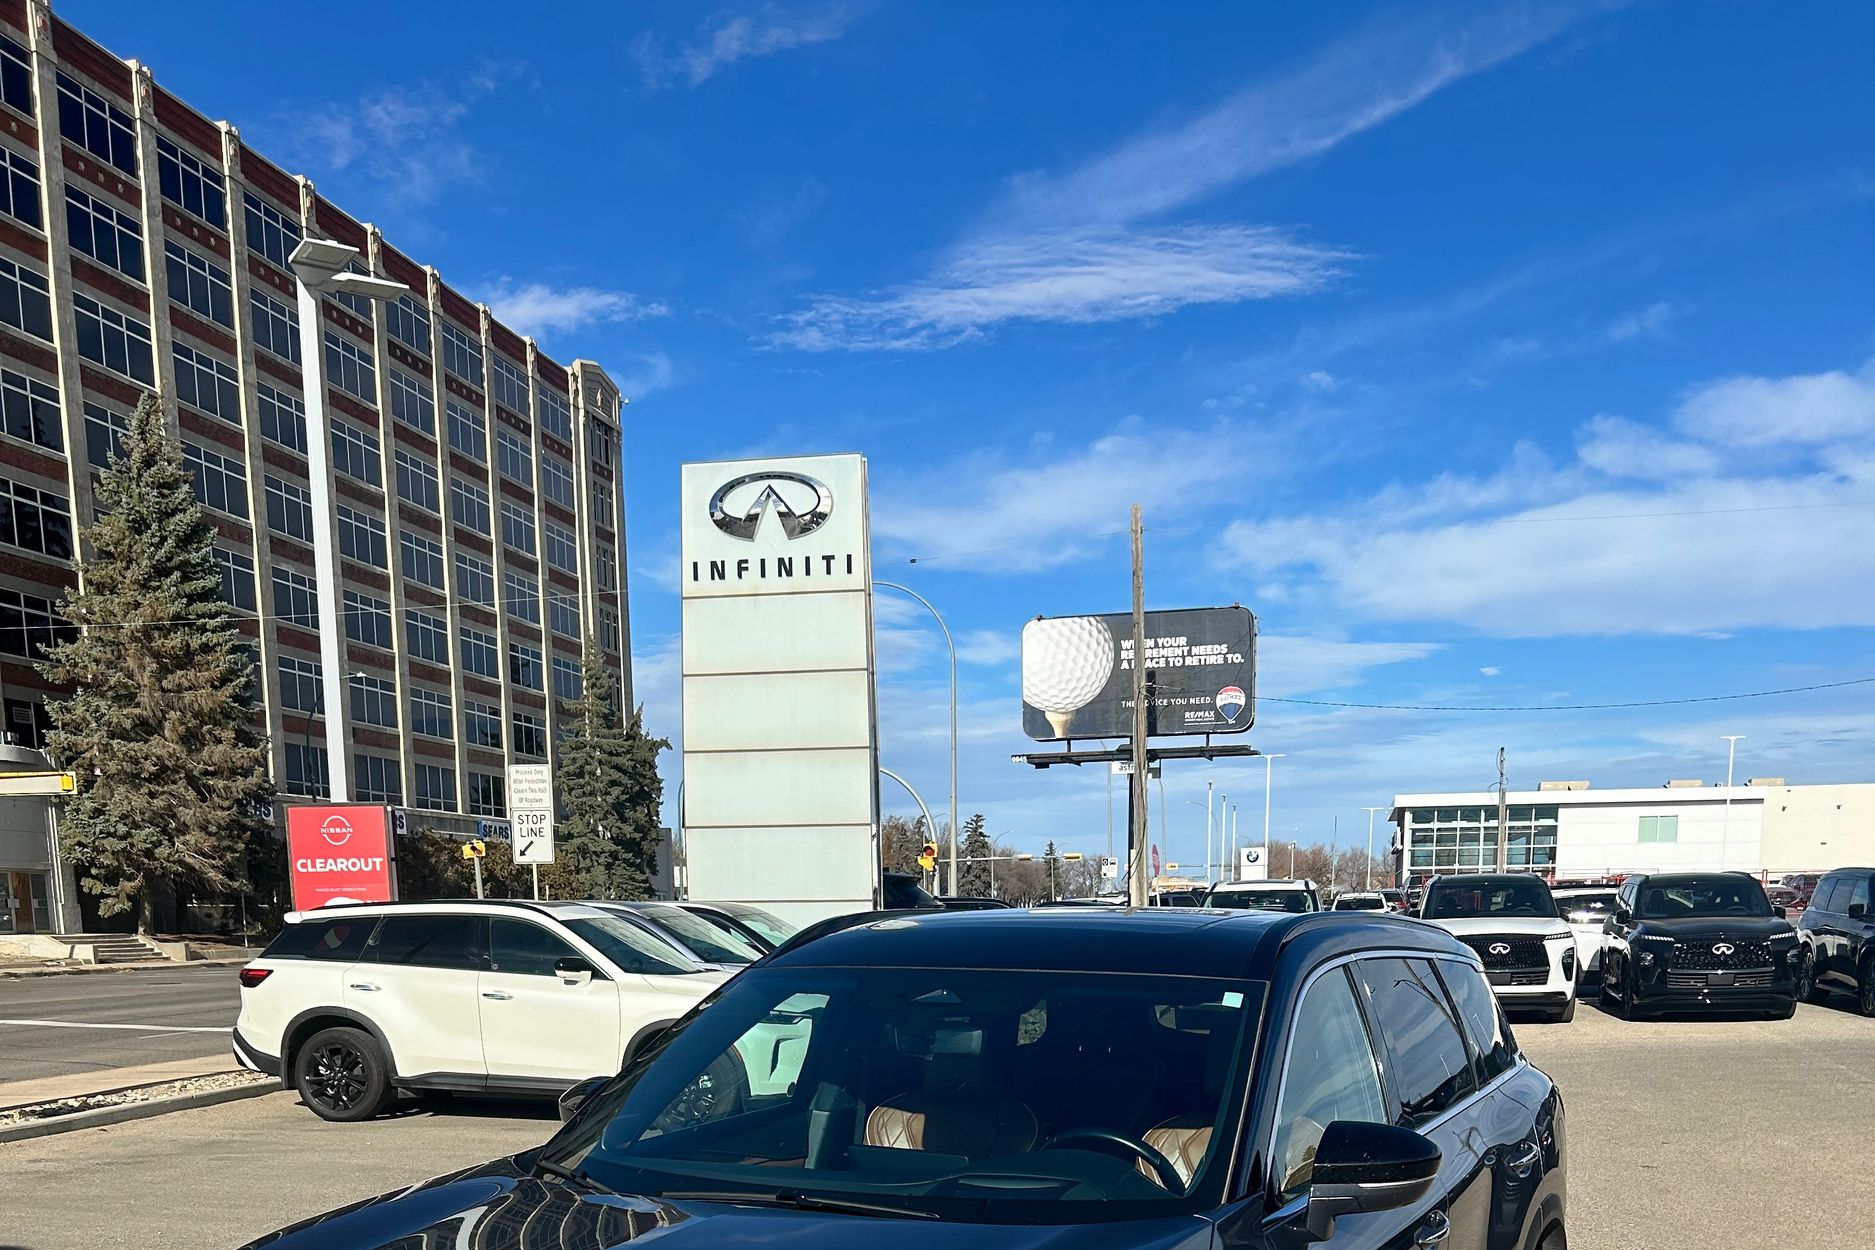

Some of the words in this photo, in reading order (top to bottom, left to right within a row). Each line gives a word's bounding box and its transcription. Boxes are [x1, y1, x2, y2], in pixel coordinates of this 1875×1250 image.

[692, 554, 852, 581] INFINITI
[1156, 637, 1187, 648] YOUR
[1120, 646, 1190, 660] REREMENT
[1191, 643, 1229, 656] NEEDS
[1120, 660, 1130, 670] A
[1167, 656, 1184, 667] TO
[1185, 654, 1225, 666] RETIRE
[1226, 653, 1245, 663] TO.
[1144, 698, 1169, 707] DVICE
[1170, 698, 1187, 706] YOU
[1189, 696, 1214, 705] NEED.
[1184, 710, 1215, 719] RE/MAX
[517, 814, 546, 825] STOP
[482, 823, 510, 840] SEARS
[520, 827, 545, 838] LINE
[296, 858, 384, 873] CLEAROUT
